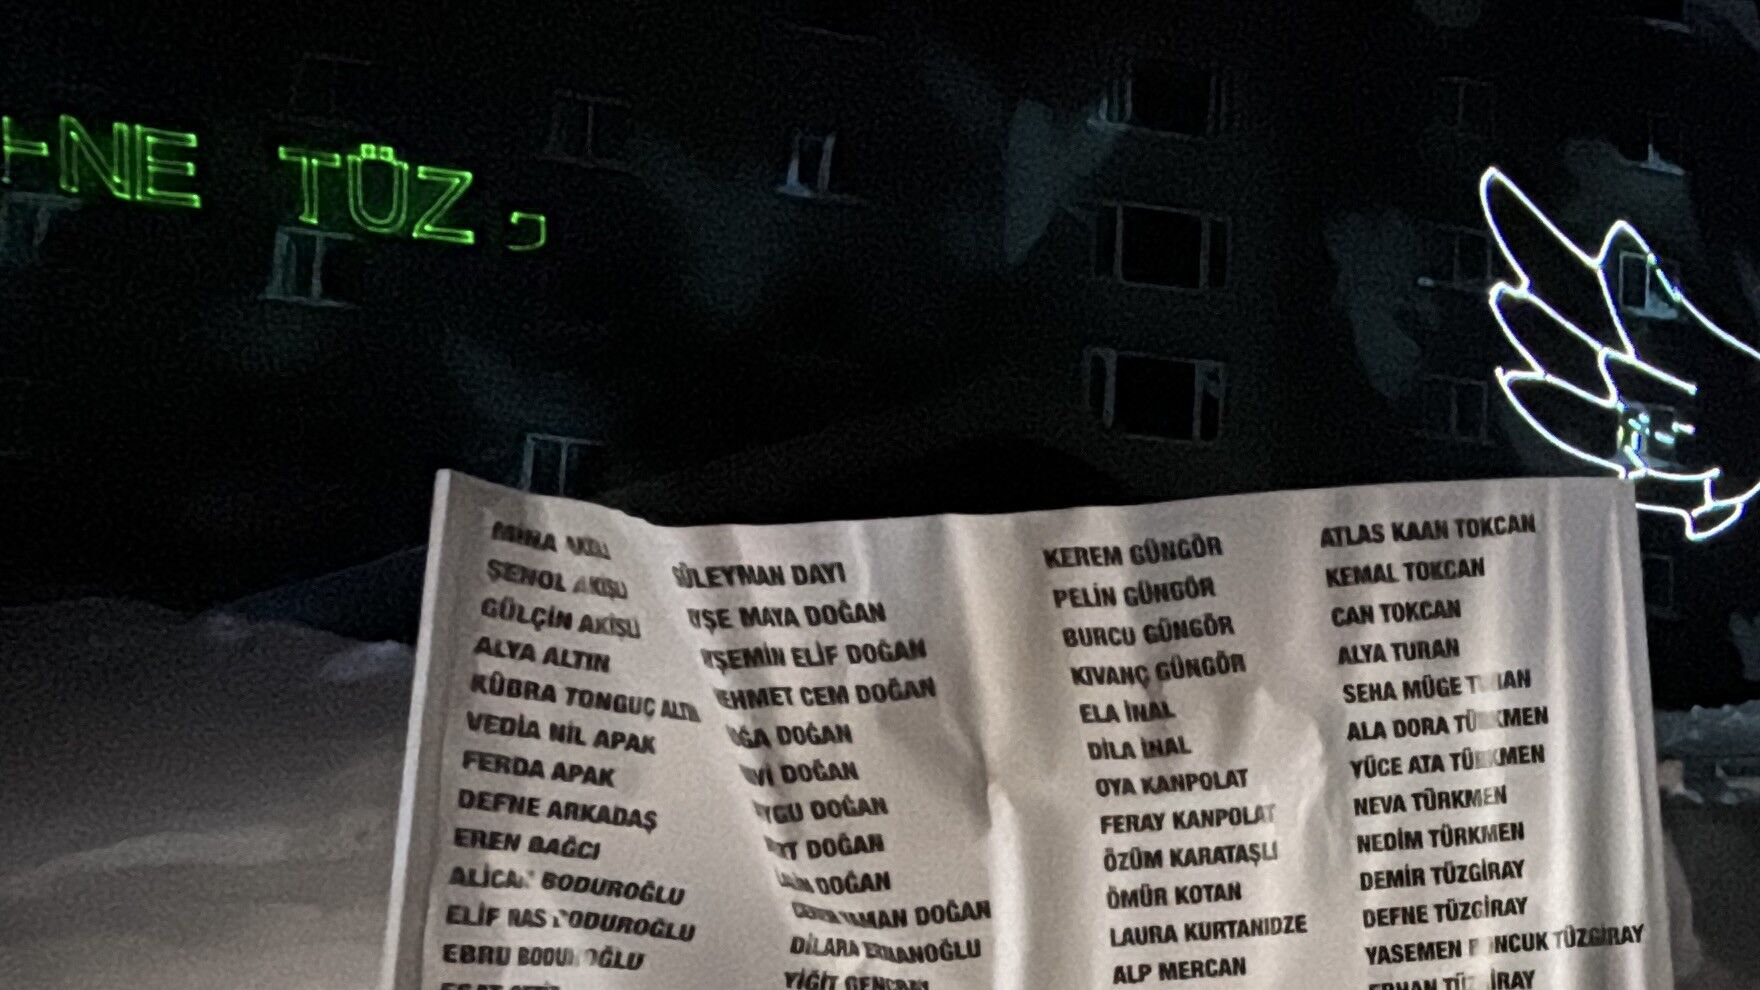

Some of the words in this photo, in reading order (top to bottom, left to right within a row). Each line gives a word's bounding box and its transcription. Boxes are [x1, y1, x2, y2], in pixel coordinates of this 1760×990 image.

[1320, 524, 1385, 548] ATLAS
[1392, 520, 1449, 542] KAAN
[1454, 513, 1536, 538] TOKCAN
[1042, 546, 1123, 569] KEREM
[1129, 533, 1224, 566] GÜNGÖR
[791, 562, 846, 586] DAYI
[1326, 563, 1399, 588] KEMAL
[1403, 557, 1486, 581] TOKCAN
[1053, 583, 1117, 608] PELİN
[1123, 574, 1216, 607] GÜNGÖR
[481, 597, 573, 631] GÜLÇİN
[739, 607, 801, 627] MAYA
[803, 600, 887, 626] DOĞAN
[1331, 604, 1374, 627] CAN
[1380, 599, 1461, 623] TOKCAN
[1062, 626, 1136, 648] BURCU
[1143, 612, 1235, 645] GÜNGÖR
[473, 637, 536, 662] ALYA
[543, 647, 610, 673] ALTIN
[791, 641, 837, 667] ELİF
[846, 638, 927, 664] DOĞAN
[1338, 644, 1388, 665] ALYA
[1390, 638, 1460, 662] TURAN
[1070, 665, 1150, 689] KIVANÇ
[1155, 651, 1247, 681] GÜNGÖR
[470, 671, 556, 701] KÜBRA
[800, 685, 849, 706] CEM
[855, 677, 936, 704] DOĞAN
[1402, 674, 1462, 700] MÜGE
[1079, 704, 1120, 723] ELA
[467, 711, 541, 739] VEDİA
[549, 721, 586, 746] NİL
[593, 730, 657, 754] APAK
[776, 721, 853, 746] DOĞAN
[1346, 721, 1386, 741] ALA
[1393, 716, 1450, 738] DORA
[1087, 738, 1136, 760] DİLA
[462, 750, 544, 779] FERDA
[551, 762, 616, 787] APAK
[780, 759, 859, 784] DOĞAN
[1350, 754, 1402, 779] YÜCE
[1408, 754, 1445, 774] ATA
[1095, 777, 1137, 797] OYA
[1140, 769, 1249, 795] KANPOLAT
[458, 789, 540, 816] DEFNE
[547, 800, 657, 834] ARKADAŞ
[810, 794, 888, 820] DOĞAN
[1353, 795, 1407, 816] NEVA
[1411, 785, 1507, 811] TÜRKMEN
[1100, 812, 1166, 834] FERAY
[1172, 804, 1276, 830] KANPOLAT
[454, 828, 521, 851] EREN
[806, 833, 884, 859] DOĞAN
[1357, 828, 1423, 853] NEDİM
[1428, 822, 1525, 848] TÜRKMEN
[1103, 847, 1163, 872] ÖZÜM
[1170, 840, 1278, 867] KARATAŞLI
[542, 871, 685, 905] BODUROĞLU
[815, 870, 891, 895] DOĞAN
[1360, 864, 1425, 891] DEMİR
[1430, 858, 1525, 884] TÜZGİRAY
[1107, 883, 1168, 909] ÖMÜR
[1175, 881, 1242, 906] KOTAN
[446, 902, 500, 926] ELİF
[915, 900, 992, 926] DOĞAN
[1363, 904, 1429, 928] DEFNE
[1434, 896, 1528, 922] TÜZGİRAY
[1110, 924, 1178, 947] LAURA
[1184, 914, 1308, 942] KURTANIDZE
[1365, 940, 1462, 965] YASEMEN
[1553, 923, 1644, 948] TÜZGİRAY
[442, 944, 511, 966] EBRU
[1113, 963, 1152, 985] ALP
[1158, 957, 1247, 981] MERCAN
